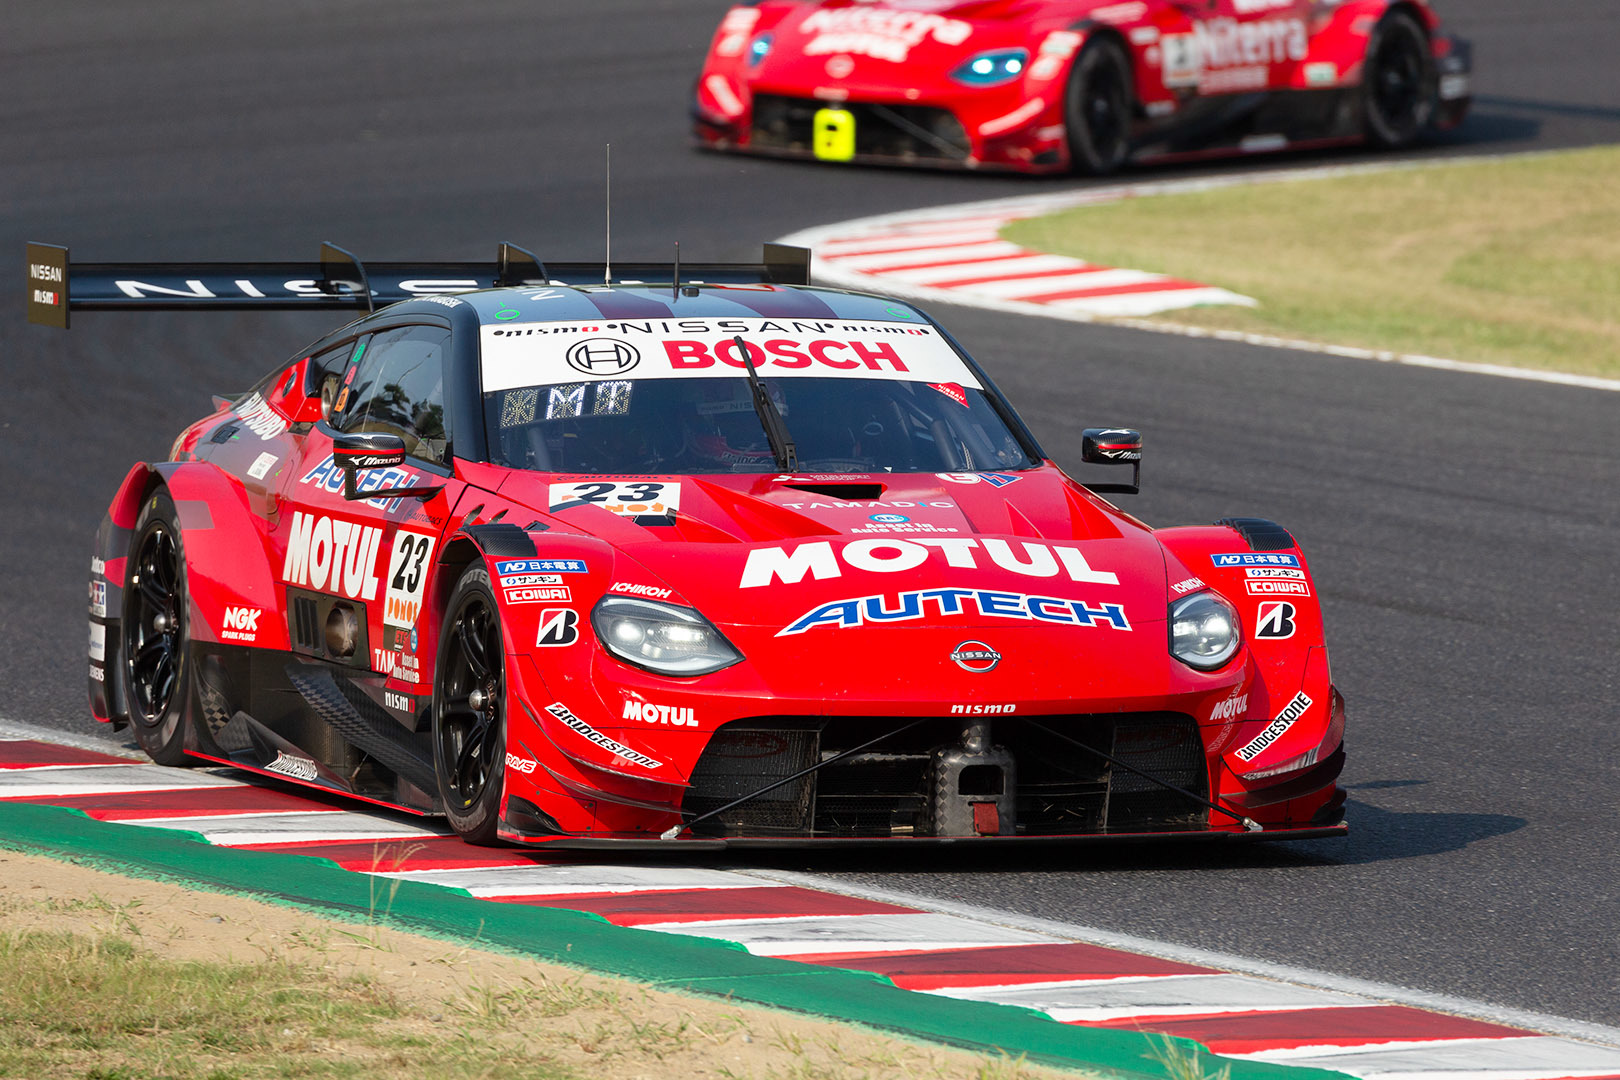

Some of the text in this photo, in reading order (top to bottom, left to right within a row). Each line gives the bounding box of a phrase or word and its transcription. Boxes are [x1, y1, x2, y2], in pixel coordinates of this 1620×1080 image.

[31, 264, 62, 282] NISSAN
[34, 289, 58, 305] nismo
[505, 320, 922, 337] nismo NISSAN nismo
[662, 338, 910, 373] BOSCH
[573, 482, 664, 502] 23
[782, 501, 954, 510] TAMADIC
[282, 511, 383, 600] MOTUL
[392, 534, 429, 593] 23
[739, 538, 1120, 588] MOTUL
[1243, 555, 1292, 565] 日本電算
[529, 561, 580, 570] 日本電算
[518, 576, 557, 584] サンキン
[1170, 577, 1206, 594] ICHIKOH
[610, 582, 672, 599] ICHIKOH
[223, 606, 262, 631] NGK
[773, 587, 1133, 637] AUTECH
[221, 630, 256, 641] SPARK PLUGS
[951, 651, 1001, 660] NISSAN
[385, 691, 416, 714] nismo
[951, 703, 1016, 714] nismo
[1209, 693, 1249, 721] MOTUL
[623, 700, 699, 727] MOTUL
[547, 703, 662, 768] BRIDGESTONE
[1236, 692, 1312, 761] BRIDGESTONE
